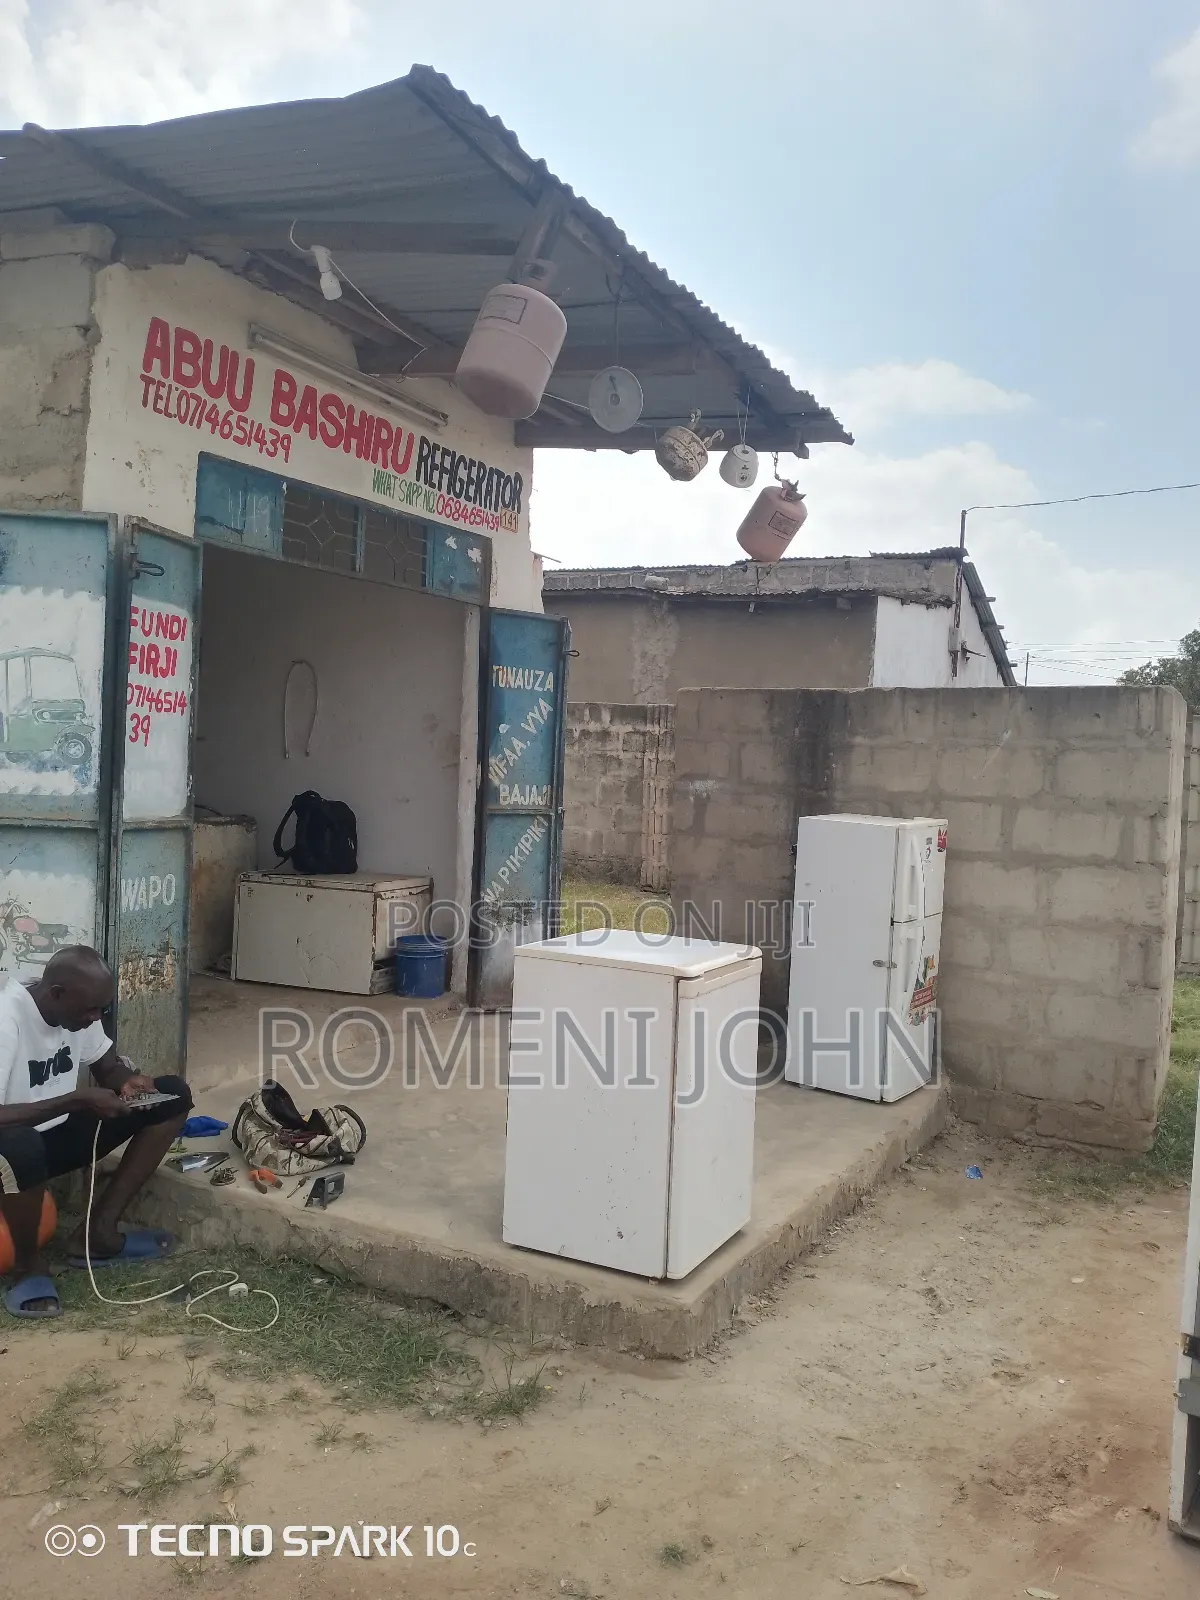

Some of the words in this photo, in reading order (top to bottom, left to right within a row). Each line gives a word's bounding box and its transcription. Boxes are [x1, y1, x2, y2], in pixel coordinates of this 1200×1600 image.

[142, 316, 255, 413] ABUU
[270, 368, 415, 474] BASHIRU
[415, 435, 524, 514] REFIGERATOR
[502, 511, 517, 530] 141
[130, 605, 188, 642] FUNDI
[128, 641, 178, 679] FIRJI
[492, 664, 554, 693] TUNAUZA
[126, 682, 187, 716] 07146514
[520, 697, 554, 735] VYA
[128, 712, 151, 748] 39
[499, 783, 552, 806] BAJAJI
[497, 814, 549, 885] PIKIPIKI
[120, 873, 176, 913] WAPO
